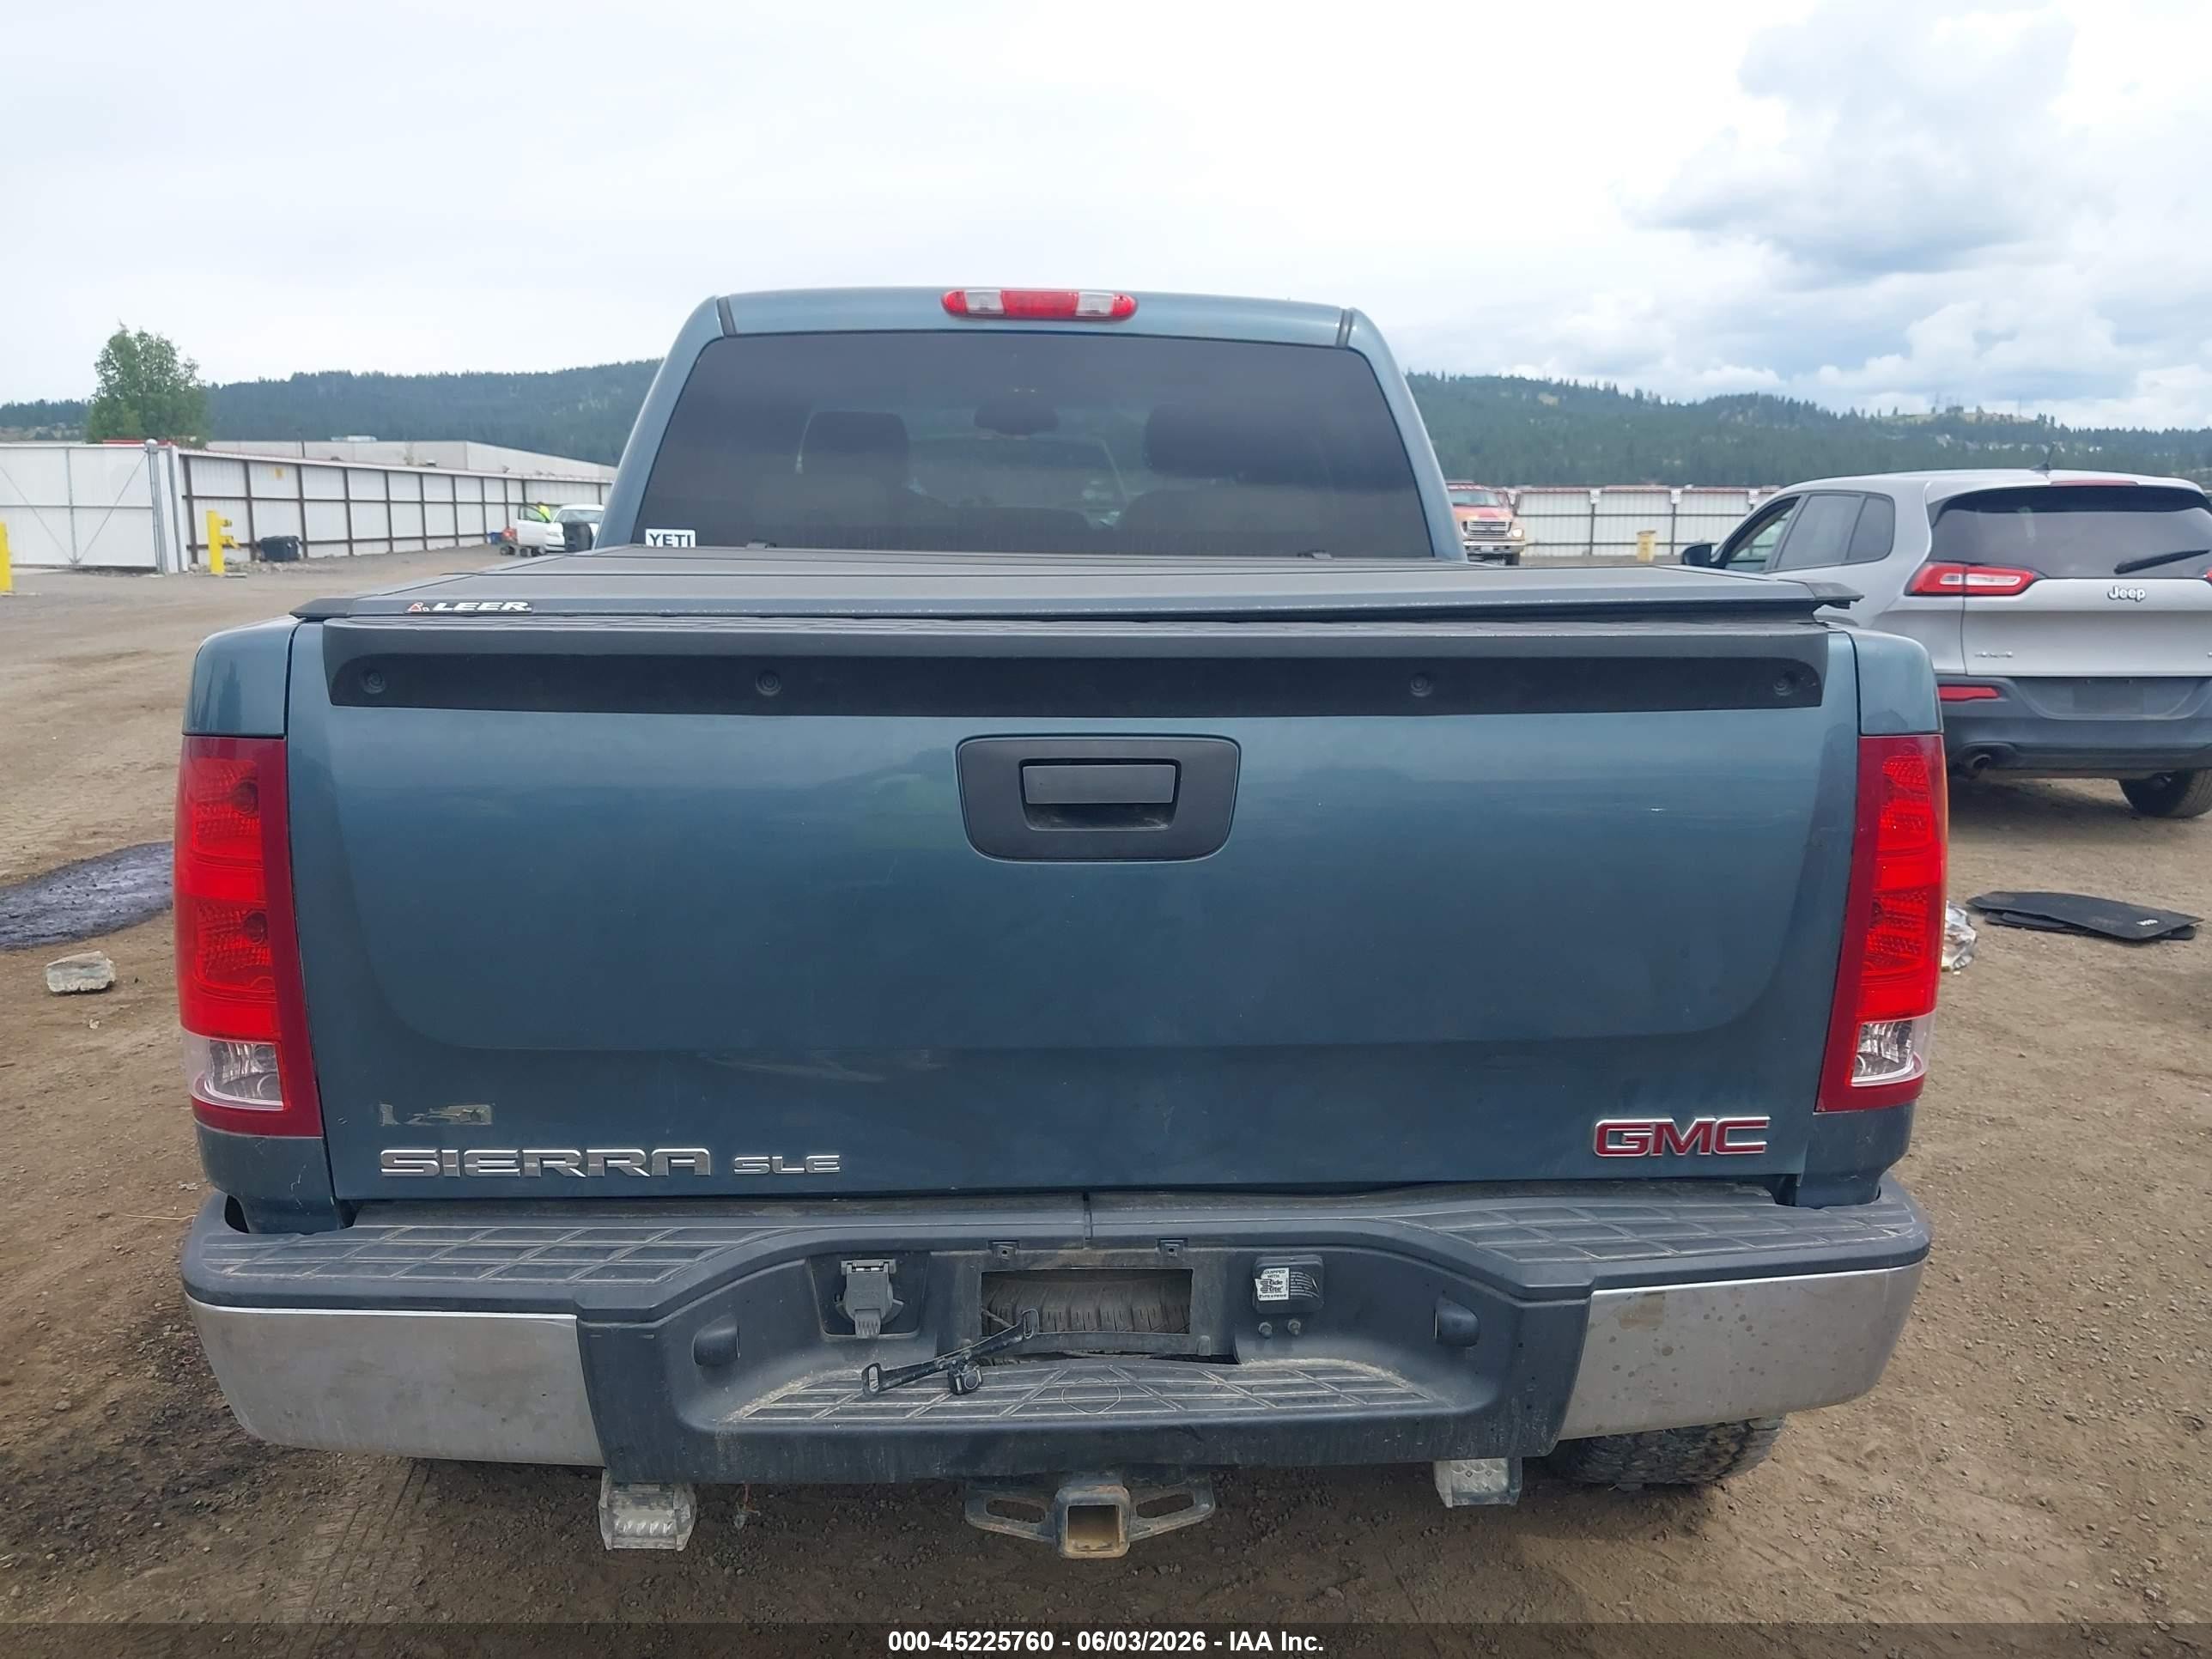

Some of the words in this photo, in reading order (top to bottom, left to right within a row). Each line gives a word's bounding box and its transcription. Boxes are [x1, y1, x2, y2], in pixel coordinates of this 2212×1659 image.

[649, 532, 691, 547] YETI
[2107, 586, 2147, 602] Jeep
[432, 601, 530, 612] LEER
[1594, 1115, 1771, 1158] GMC
[379, 1147, 713, 1178] SIERRA
[732, 1154, 841, 1176] SLE
